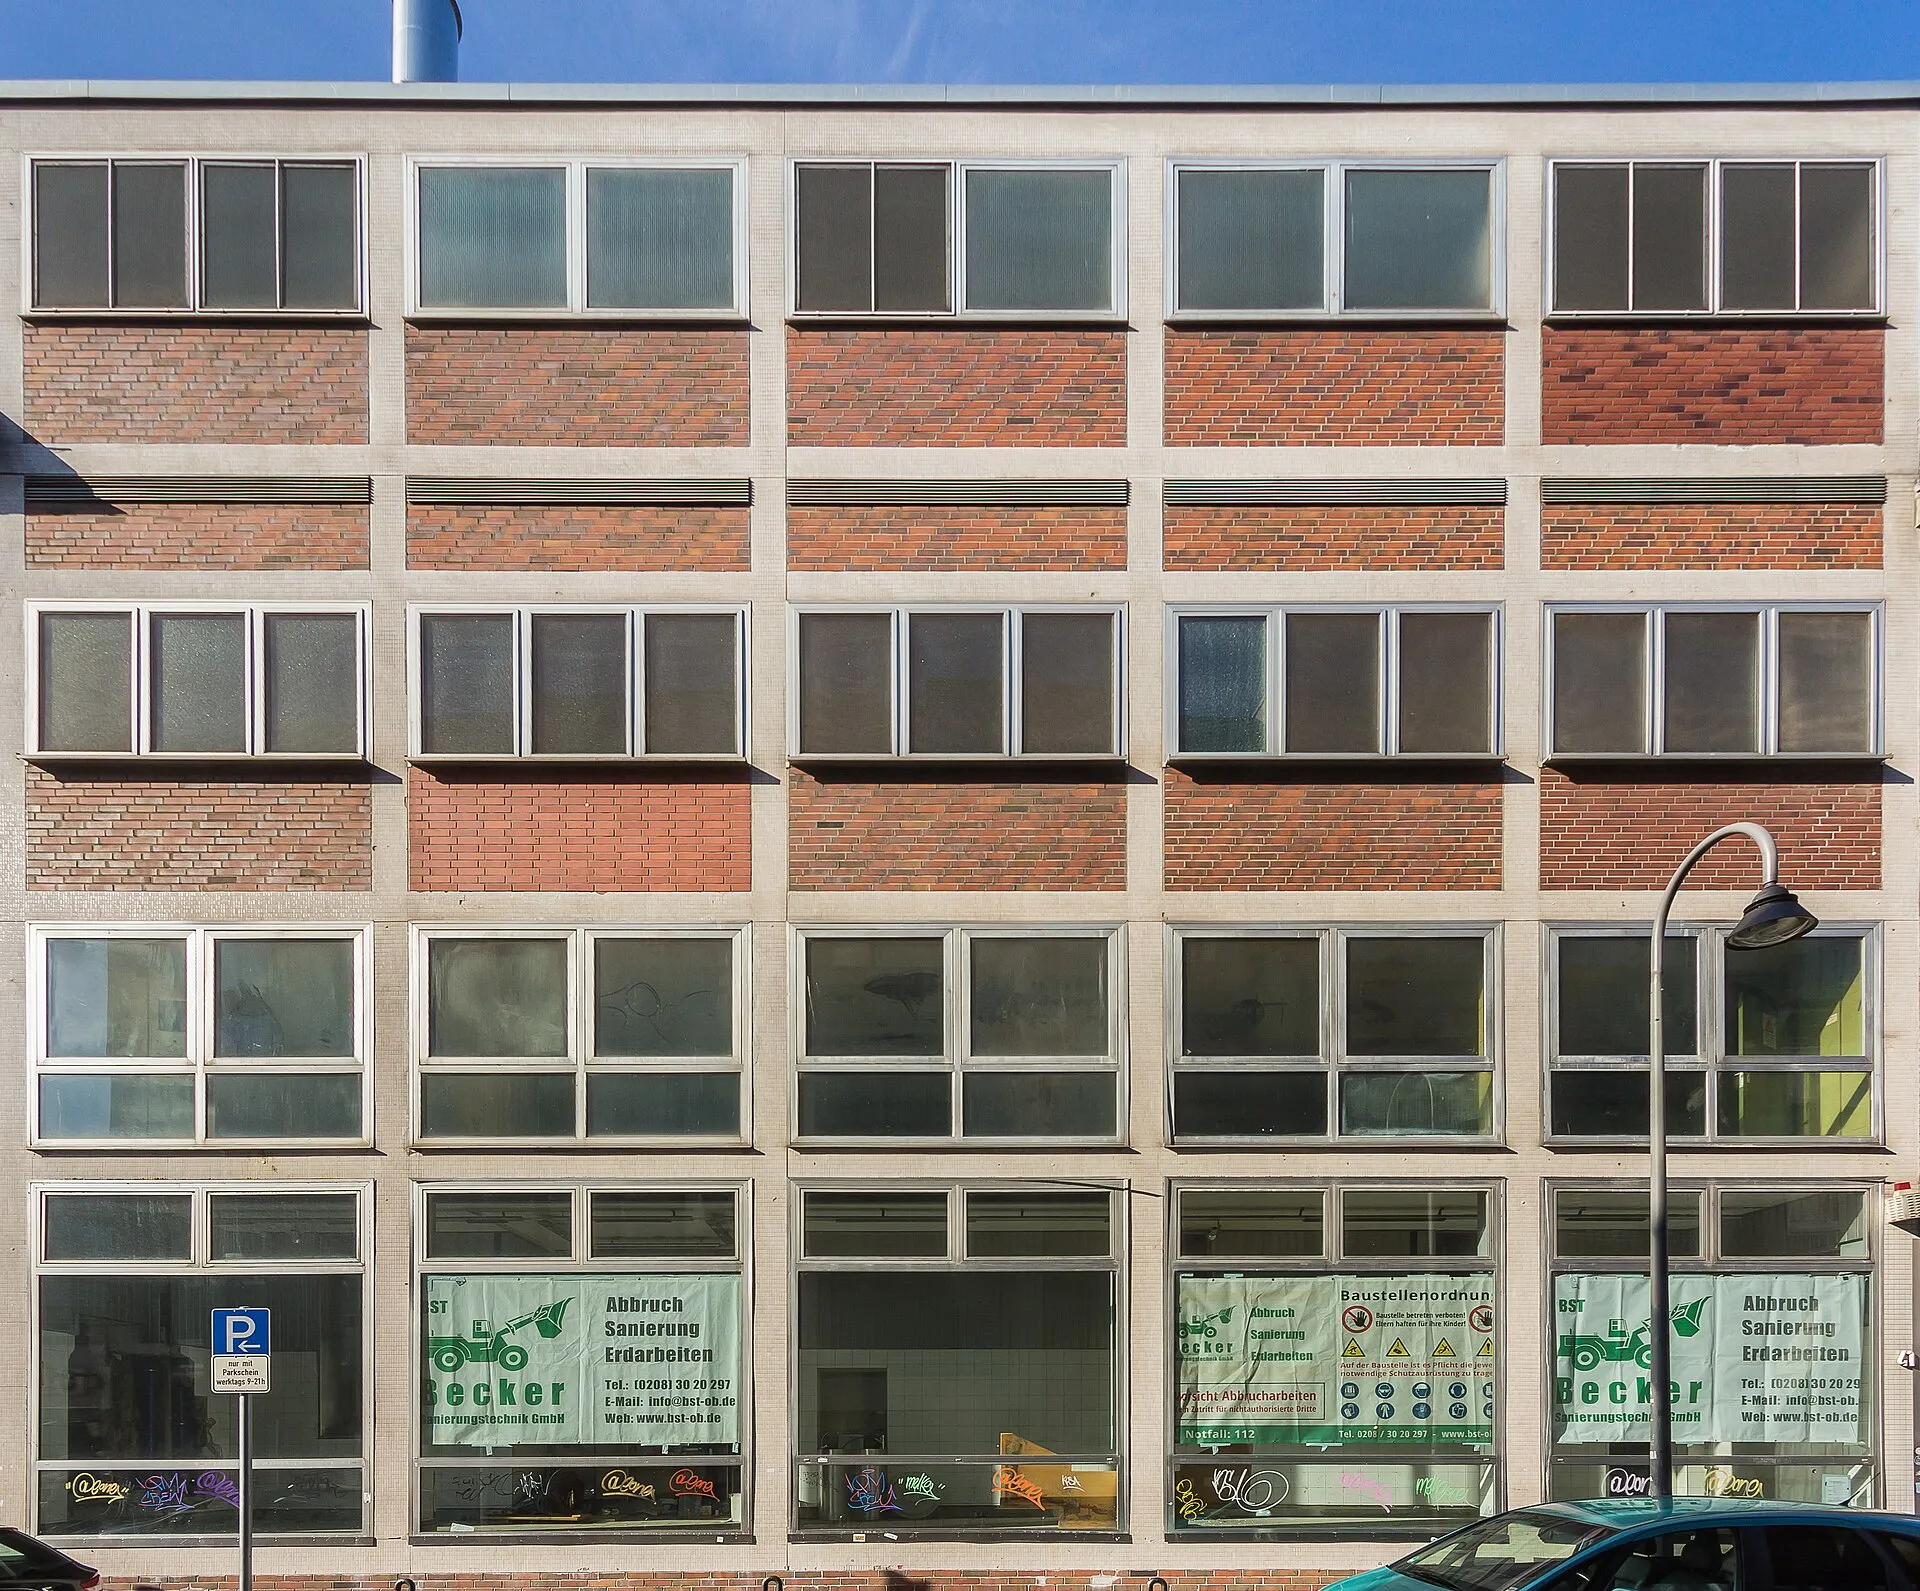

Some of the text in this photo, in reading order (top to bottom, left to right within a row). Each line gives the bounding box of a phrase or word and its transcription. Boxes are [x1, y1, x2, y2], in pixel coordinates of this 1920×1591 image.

[606, 1296, 683, 1313] Abbruch
[1558, 1299, 1586, 1313] BST
[1743, 1295, 1819, 1312] Abbruch
[1250, 1307, 1295, 1319] Abbruch
[1375, 1312, 1466, 1320] Baustelle betreten verboten!
[604, 1320, 700, 1339] Sanierung
[1418, 1320, 1428, 1329] für
[1443, 1320, 1466, 1329] Kinder!
[1741, 1319, 1836, 1338] Sanierung
[226, 1315, 256, 1353] P
[1250, 1329, 1306, 1341] Sanierung
[1180, 1341, 1234, 1354] ecker
[1742, 1345, 1849, 1362] Erdarbeiten
[605, 1346, 714, 1363] Erdarbeiten
[1251, 1351, 1313, 1362] Erdarbeiten
[242, 1359, 253, 1367] mit
[222, 1368, 259, 1376] Parkschein
[1340, 1370, 1387, 1379] notwendige
[216, 1378, 246, 1387] werktags
[604, 1379, 731, 1391] Tel.: (0208) 30 20 297
[1741, 1379, 1764, 1389] Tel.:
[1771, 1378, 1808, 1390] (0208)
[1810, 1379, 1827, 1389] 30
[1829, 1379, 1843, 1389] 20
[1222, 1389, 1317, 1402] Abbrucharbeiten
[1741, 1395, 1781, 1406] E-Mail:
[605, 1396, 736, 1408] E-Mail: info@bst-ob.de
[1191, 1405, 1214, 1414] Zutritt
[1216, 1405, 1228, 1414] für
[1297, 1405, 1317, 1414] Dritte
[532, 1413, 566, 1425] GmbH
[604, 1413, 722, 1424] Web: www.bst-ob.de
[1741, 1412, 1858, 1423] Web: www.bst-ob.de
[1185, 1429, 1256, 1439] Notfall: 112
[1339, 1430, 1355, 1438] Tel.
[1357, 1430, 1378, 1438] 0208
[1386, 1430, 1397, 1438] 30
[1399, 1430, 1410, 1438] 20
[1412, 1430, 1428, 1438] 297
